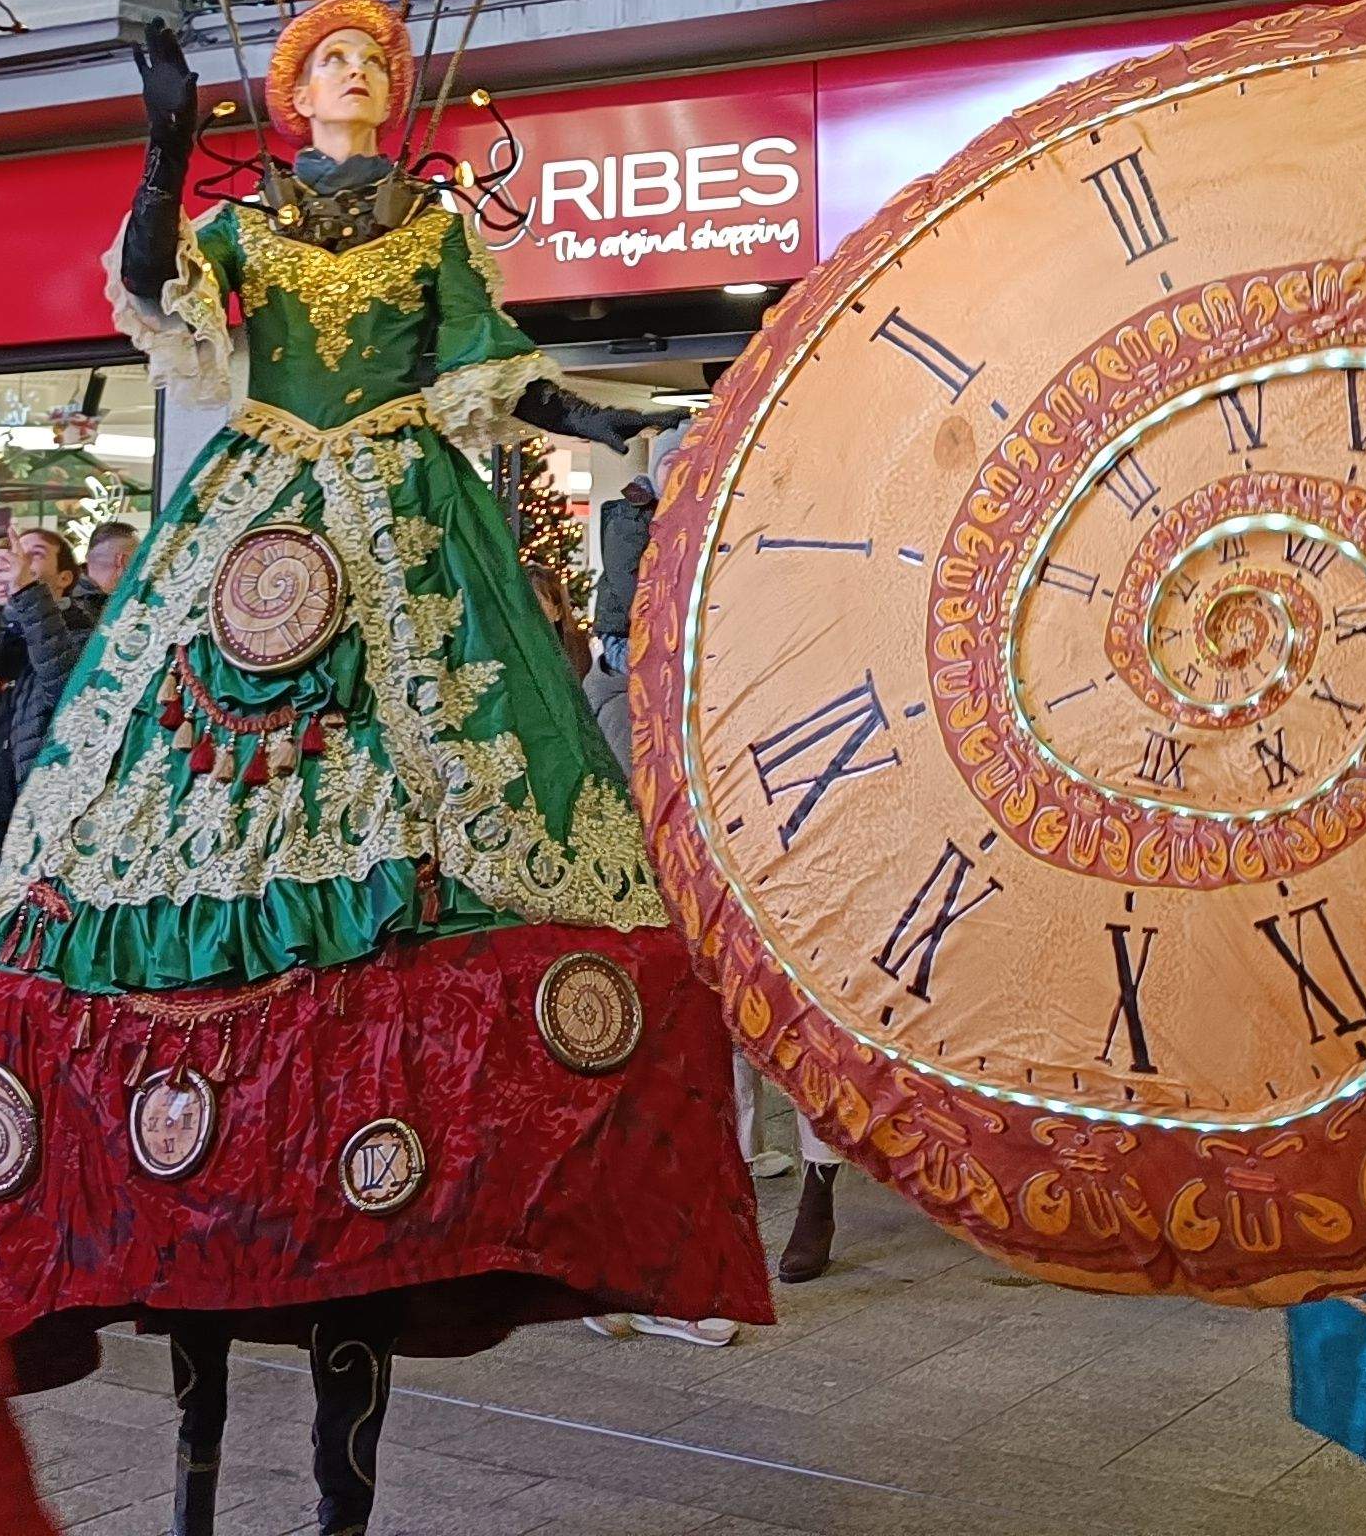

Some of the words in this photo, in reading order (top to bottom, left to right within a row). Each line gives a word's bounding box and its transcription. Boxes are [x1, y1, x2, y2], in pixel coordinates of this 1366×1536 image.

[541, 137, 801, 226] RIBES
[548, 226, 597, 263] The
[599, 221, 687, 267] original
[691, 217, 801, 258] shopping
